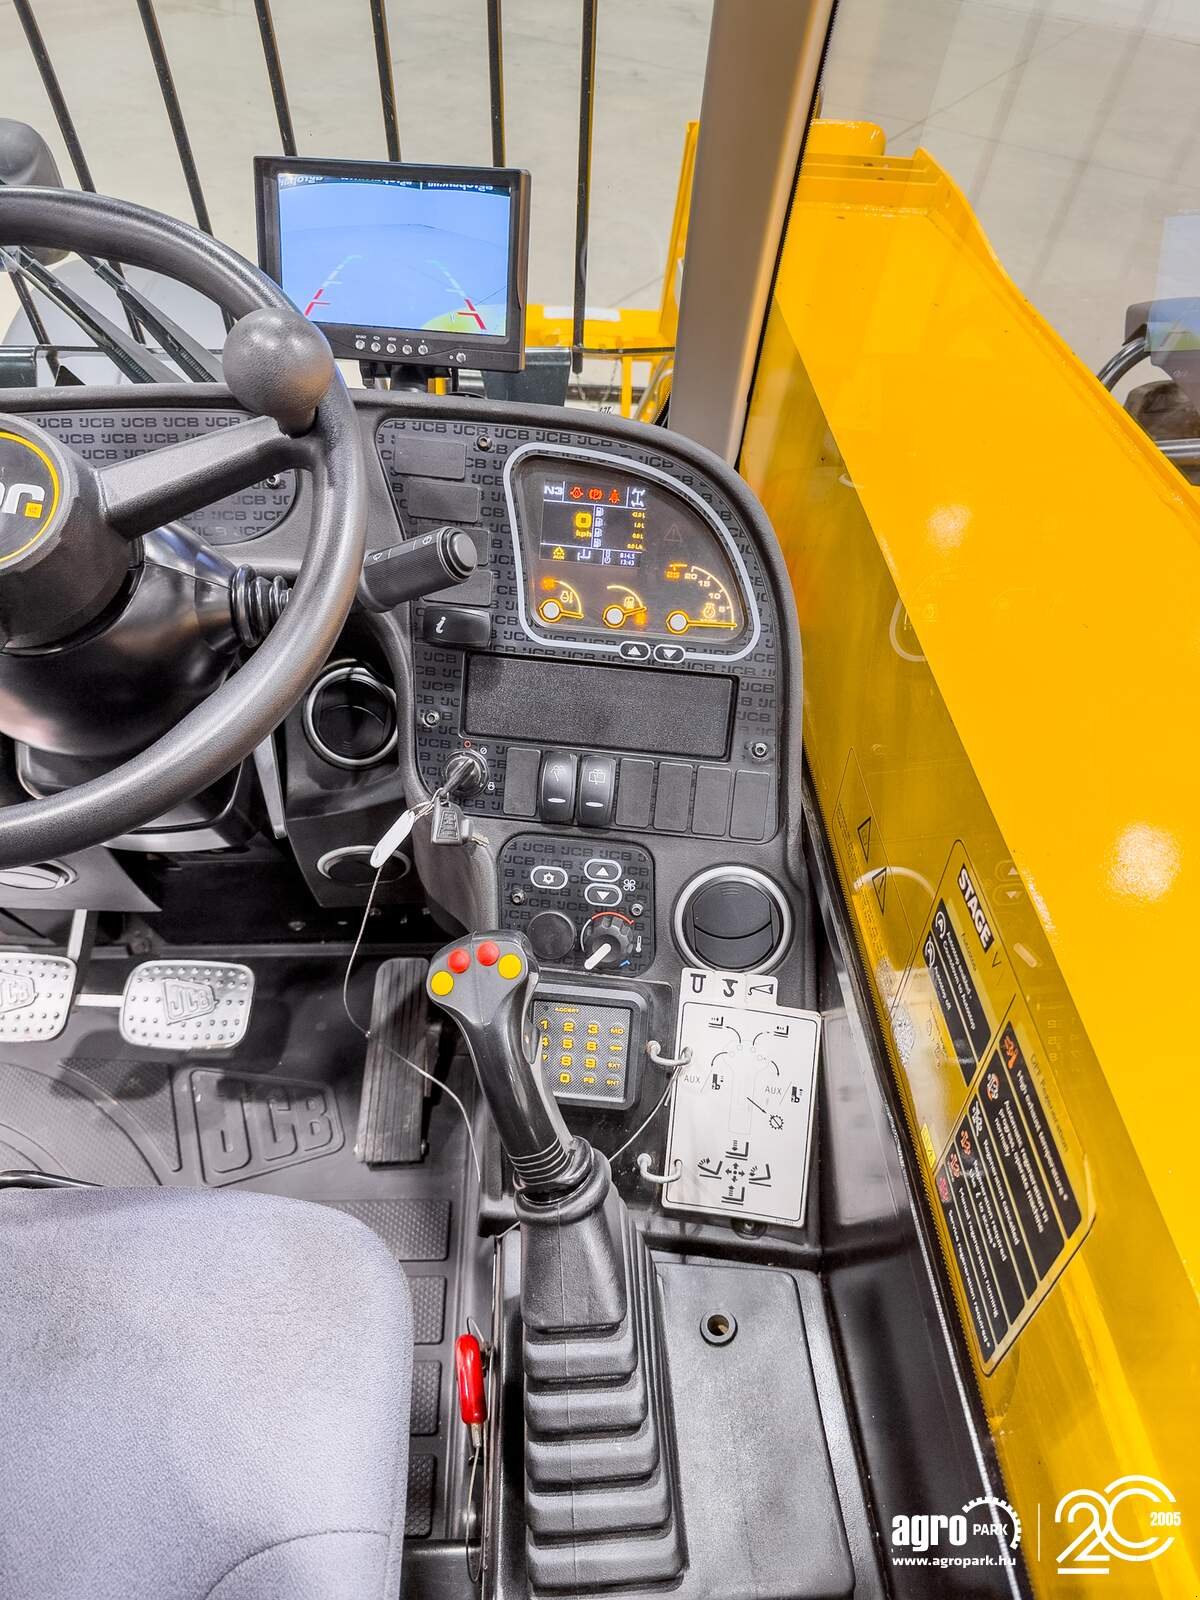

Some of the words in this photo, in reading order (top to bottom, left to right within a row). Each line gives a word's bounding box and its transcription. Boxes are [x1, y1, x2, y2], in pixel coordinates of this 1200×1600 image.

[37, 418, 73, 428] JCB
[80, 418, 115, 428] JCB
[121, 417, 157, 428] JCB
[163, 417, 199, 427] JCB
[412, 421, 447, 433] JCB
[494, 428, 530, 440] JCB
[535, 431, 571, 444] JCB
[59, 434, 95, 444] JCB
[101, 434, 137, 443] JCB
[143, 434, 179, 443] JCB
[82, 450, 118, 460] JCB
[544, 486, 563, 495] N3
[480, 507, 504, 517] CB
[576, 529, 592, 538] kph
[424, 652, 456, 663] JCB
[443, 668, 461, 678] JC
[422, 681, 455, 692] JCB
[741, 682, 774, 693] JCB
[441, 697, 459, 707] JC
[737, 711, 770, 722] JCB
[439, 726, 458, 735] JC
[419, 737, 450, 748] JCB
[523, 842, 555, 853] JCB
[561, 846, 593, 857] JCB
[600, 849, 632, 861] JCB
[504, 855, 535, 865] JCB
[539, 886, 571, 897] JCB
[557, 901, 589, 912] JCB
[958, 866, 990, 949] STAGE
[992, 952, 1001, 968] V
[170, 985, 210, 1016] JCB
[541, 1021, 547, 1029] 1
[563, 1022, 574, 1032] 2
[588, 1024, 598, 1034] 3
[563, 1039, 573, 1049] 5
[586, 1041, 597, 1051] 6
[561, 1056, 572, 1066] 8
[585, 1058, 596, 1068] 9
[560, 1073, 570, 1083] 0
[684, 1075, 700, 1083] AUX
[765, 1086, 782, 1095] AUX
[1016, 1069, 1027, 1094] High
[1025, 1092, 1041, 1131] exhaust
[213, 1078, 334, 1173] JCB
[994, 1117, 1009, 1158] normally
[1004, 1099, 1022, 1147] Automatic
[1020, 1147, 1042, 1207] regeneration
[983, 1139, 1003, 1200] Regeneration
[1002, 1199, 1019, 1245] cancelled
[1013, 1150, 1028, 1190] operate
[1027, 1189, 1043, 1232] machine
[973, 1159, 993, 1219] Regeneration
[991, 1218, 1006, 1261] required
[959, 1187, 970, 1220] Manual
[968, 1220, 986, 1279] regeneration
[985, 1279, 998, 1317] running
[956, 1242, 975, 1301] regeneration
